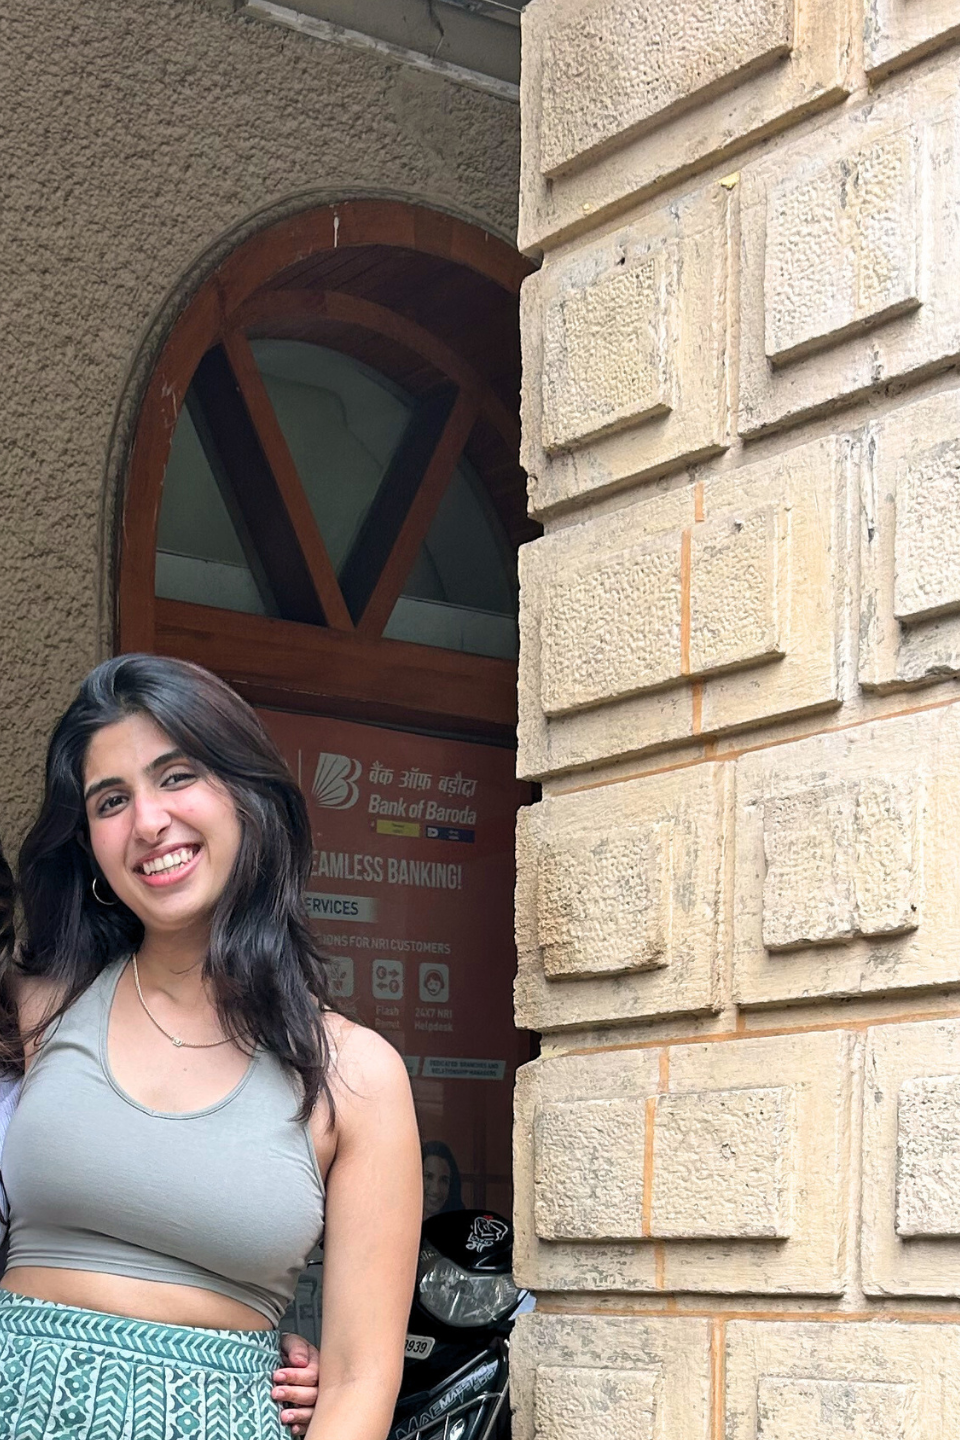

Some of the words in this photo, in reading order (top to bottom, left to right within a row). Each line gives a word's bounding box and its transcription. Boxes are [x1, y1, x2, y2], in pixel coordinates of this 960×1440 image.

[369, 760, 394, 785] बैंक
[368, 794, 407, 817] Bank
[409, 799, 425, 818] of
[425, 801, 477, 825] Baroda
[311, 850, 383, 883] EAMLESS
[387, 858, 462, 890] BANKING!
[305, 897, 359, 916] ERVICES
[349, 936, 370, 949] FOR
[371, 937, 389, 950] NRI
[391, 939, 451, 954] CUSTOMERS
[375, 1006, 399, 1016] Flash
[437, 1008, 453, 1019] NRI
[414, 1020, 453, 1032] Helpdesk
